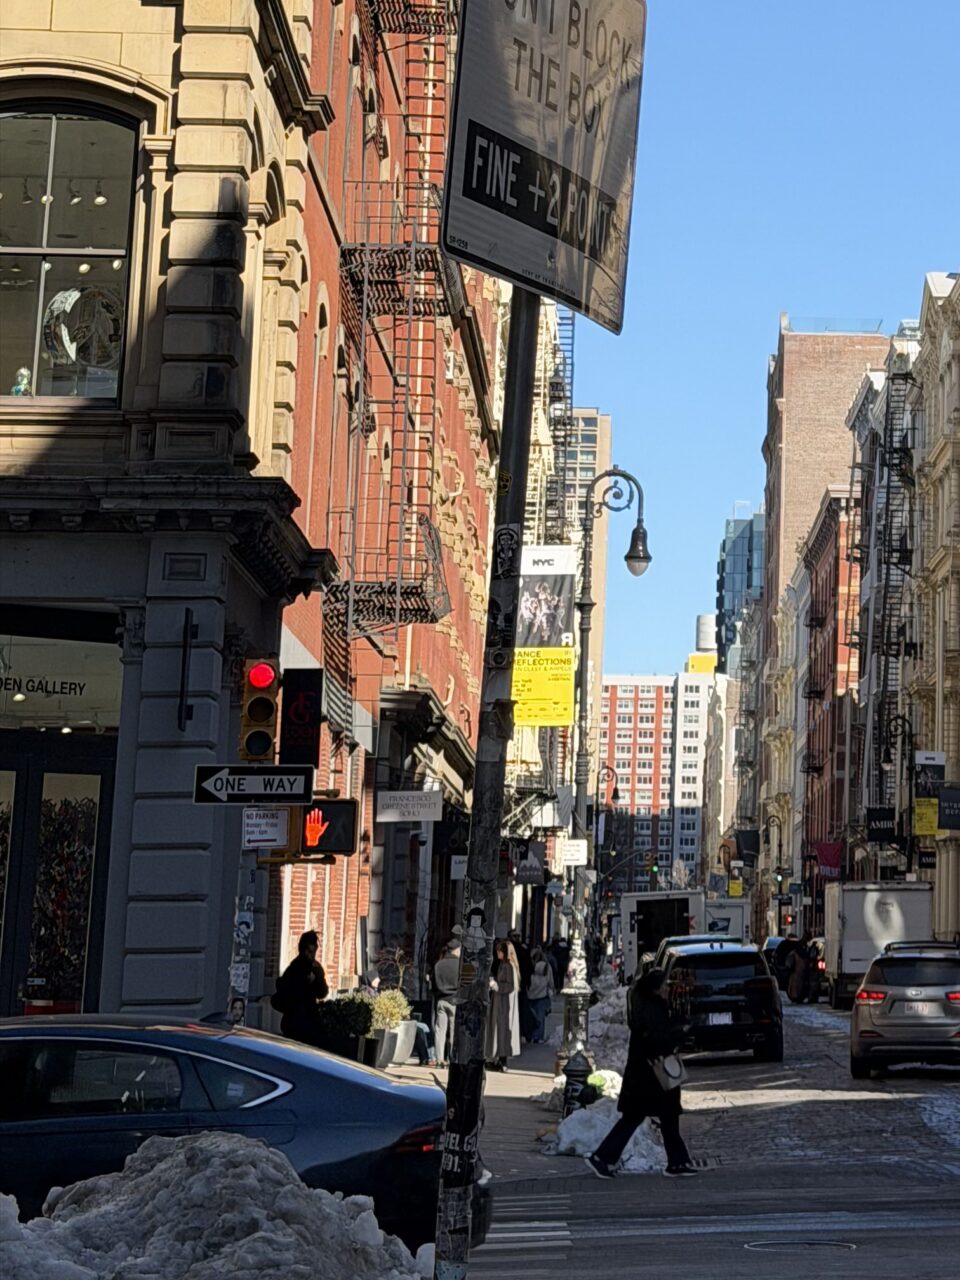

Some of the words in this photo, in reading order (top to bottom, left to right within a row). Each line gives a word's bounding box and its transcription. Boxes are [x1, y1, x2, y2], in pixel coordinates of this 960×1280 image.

[513, 37, 560, 112] THE
[567, 71, 608, 141] BOX
[472, 135, 521, 208] FINE
[528, 170, 561, 226] +2
[566, 183, 618, 257] PONTS
[532, 558, 555, 567] NYC
[514, 650, 541, 658] ANCE
[513, 657, 572, 666] EFLECTIONS
[25, 678, 86, 696] GALLERY
[214, 777, 246, 792] ONE
[263, 777, 298, 792] WAY
[246, 812, 254, 820] NO
[255, 812, 279, 820] PARKING
